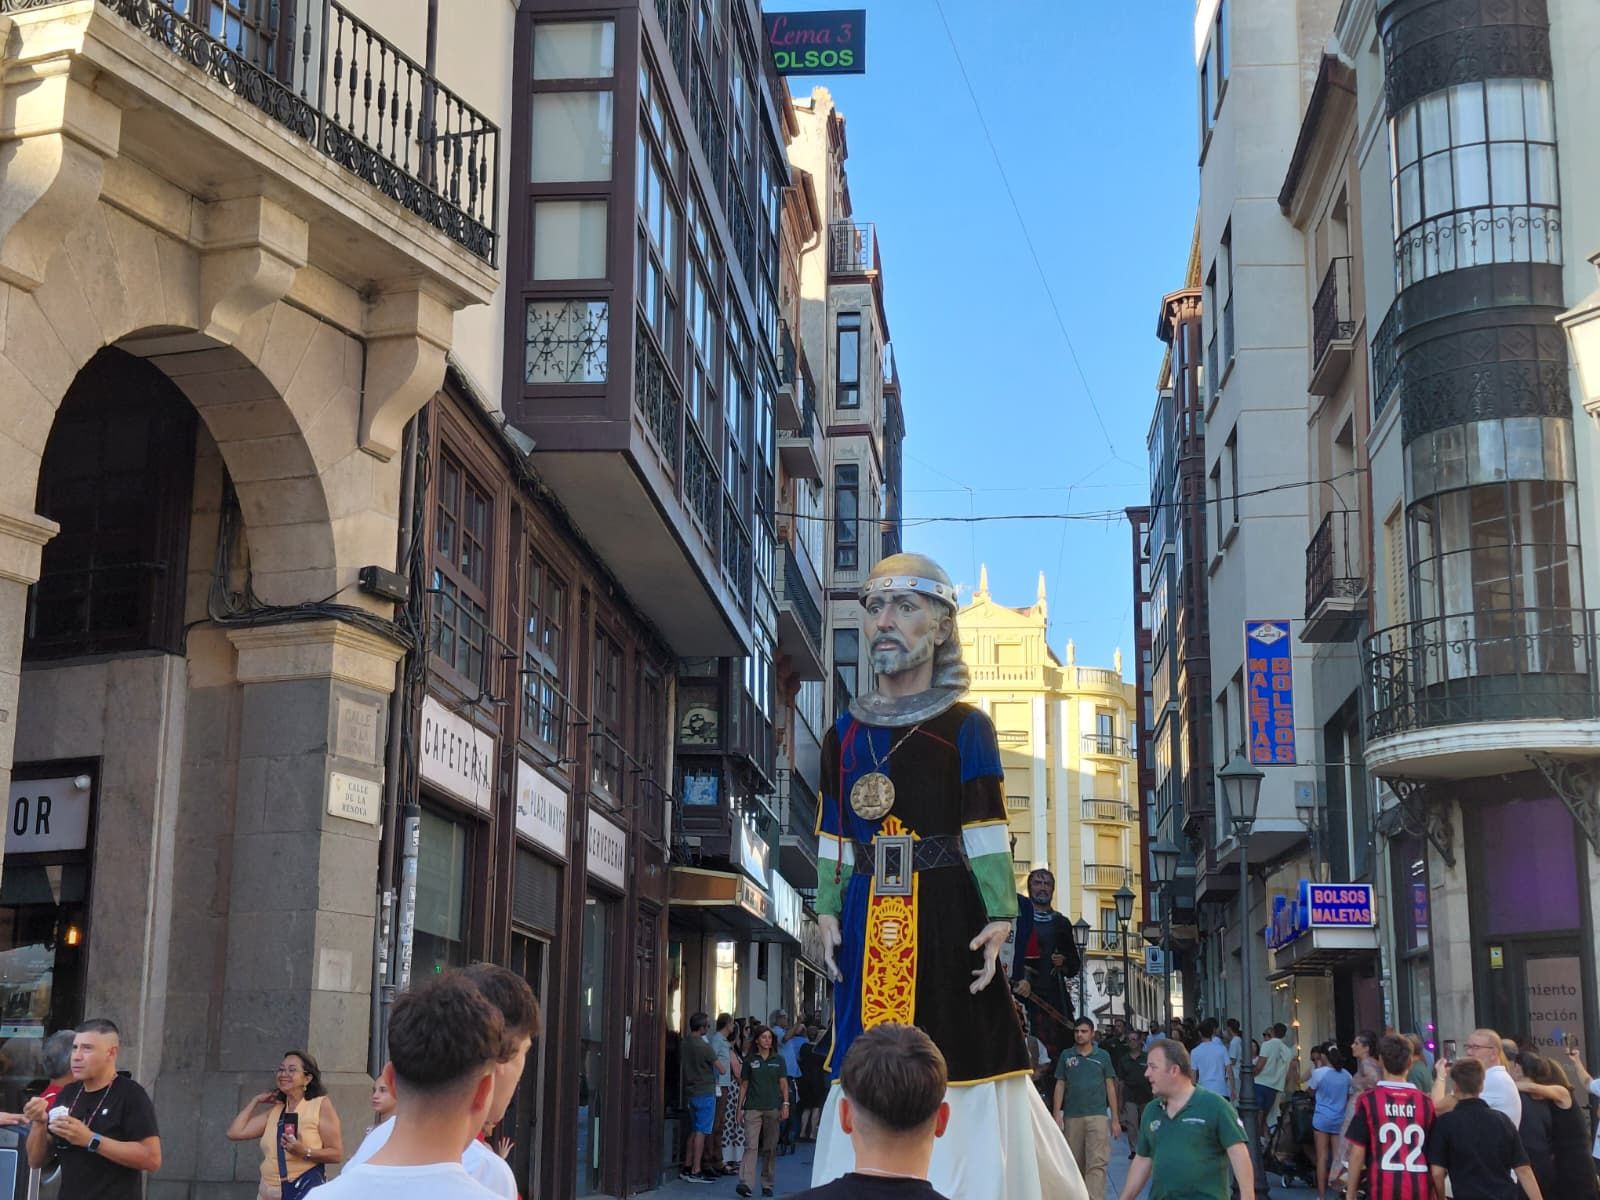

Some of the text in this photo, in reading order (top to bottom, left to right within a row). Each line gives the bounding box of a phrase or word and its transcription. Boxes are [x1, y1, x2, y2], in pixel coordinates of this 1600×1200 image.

[770, 16, 852, 46] Lema 3
[1249, 658, 1272, 762] MALETAS
[1271, 657, 1294, 762] BOLSOS
[345, 793, 366, 806] DE LA
[348, 782, 368, 795] CALLE
[530, 789, 547, 824] PLAZA
[1314, 889, 1366, 904] BOLSOS
[1312, 908, 1370, 923] MALETAS
[1379, 1121, 1429, 1173] 22
